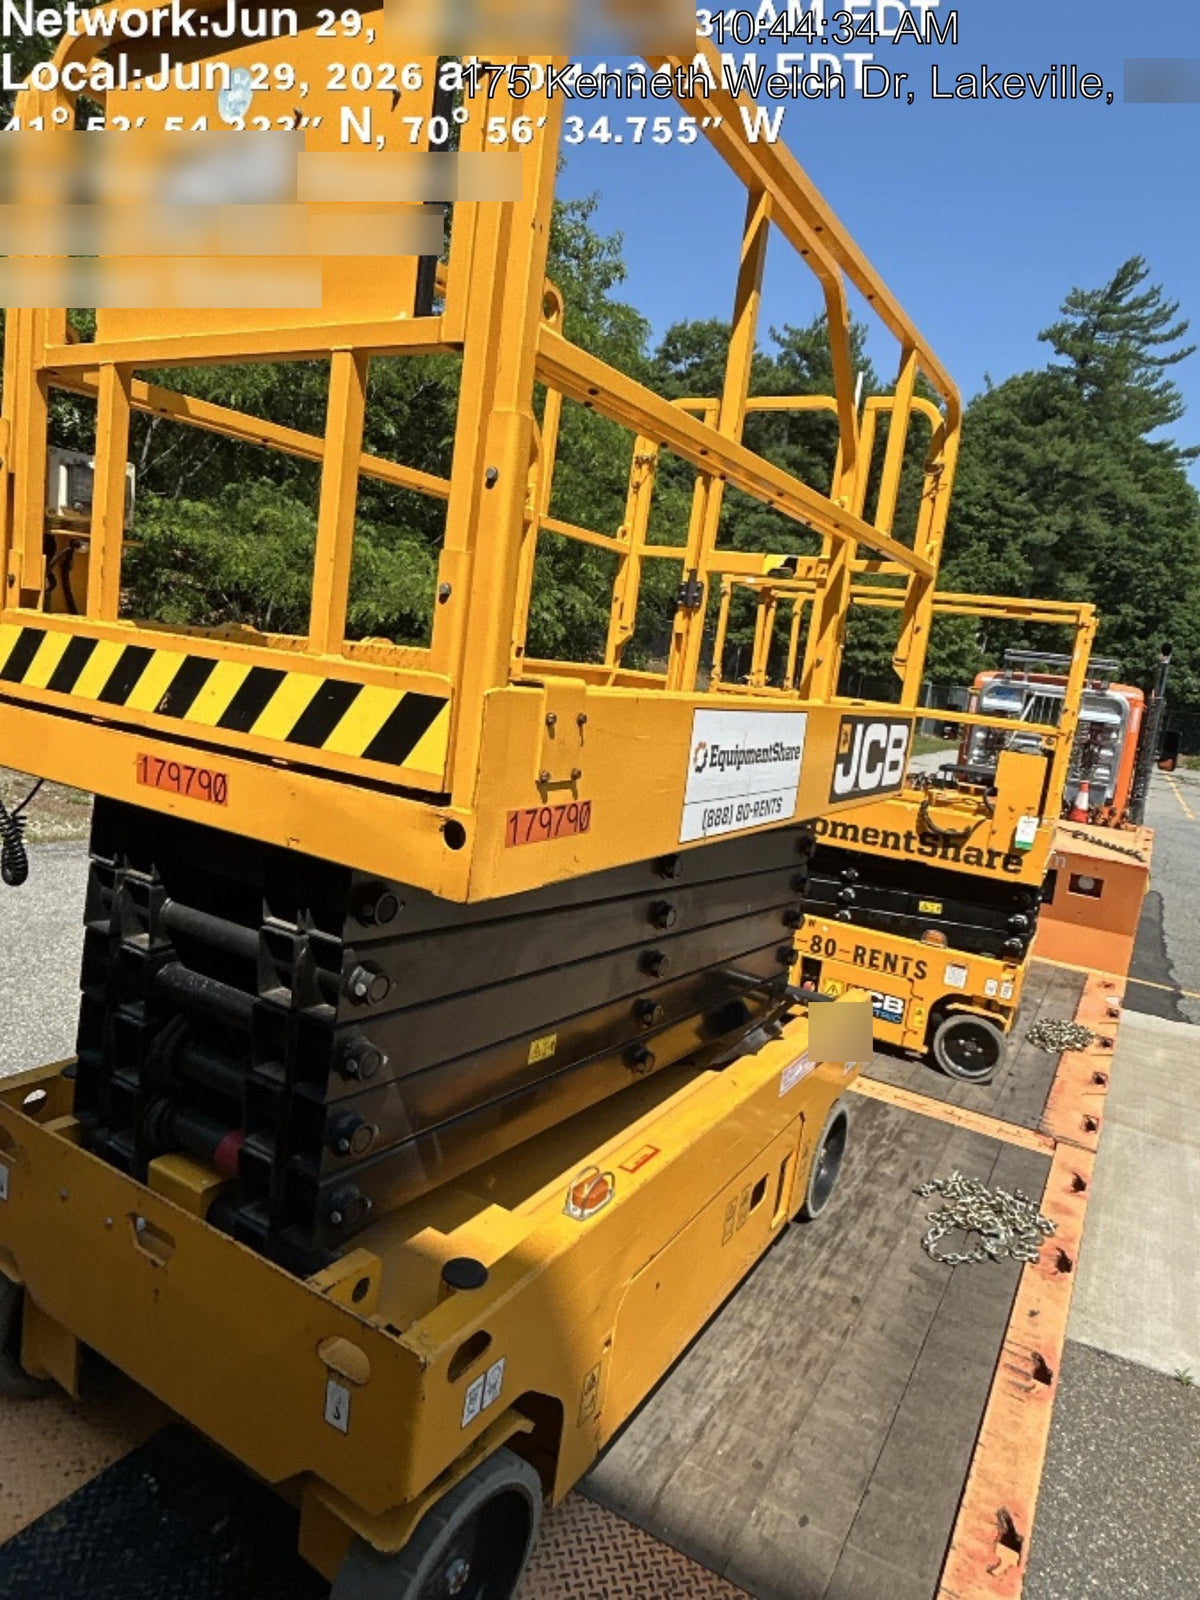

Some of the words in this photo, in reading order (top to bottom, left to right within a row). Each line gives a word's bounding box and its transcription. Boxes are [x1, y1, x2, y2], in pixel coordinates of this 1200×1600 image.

[709, 742, 801, 773] EquipmentShare
[834, 722, 909, 795] JCB
[142, 754, 228, 805] 179790
[509, 801, 591, 845] 179790
[702, 804, 734, 830] (888)
[736, 797, 783, 822] 80-RENTS
[870, 991, 904, 1014] CB
